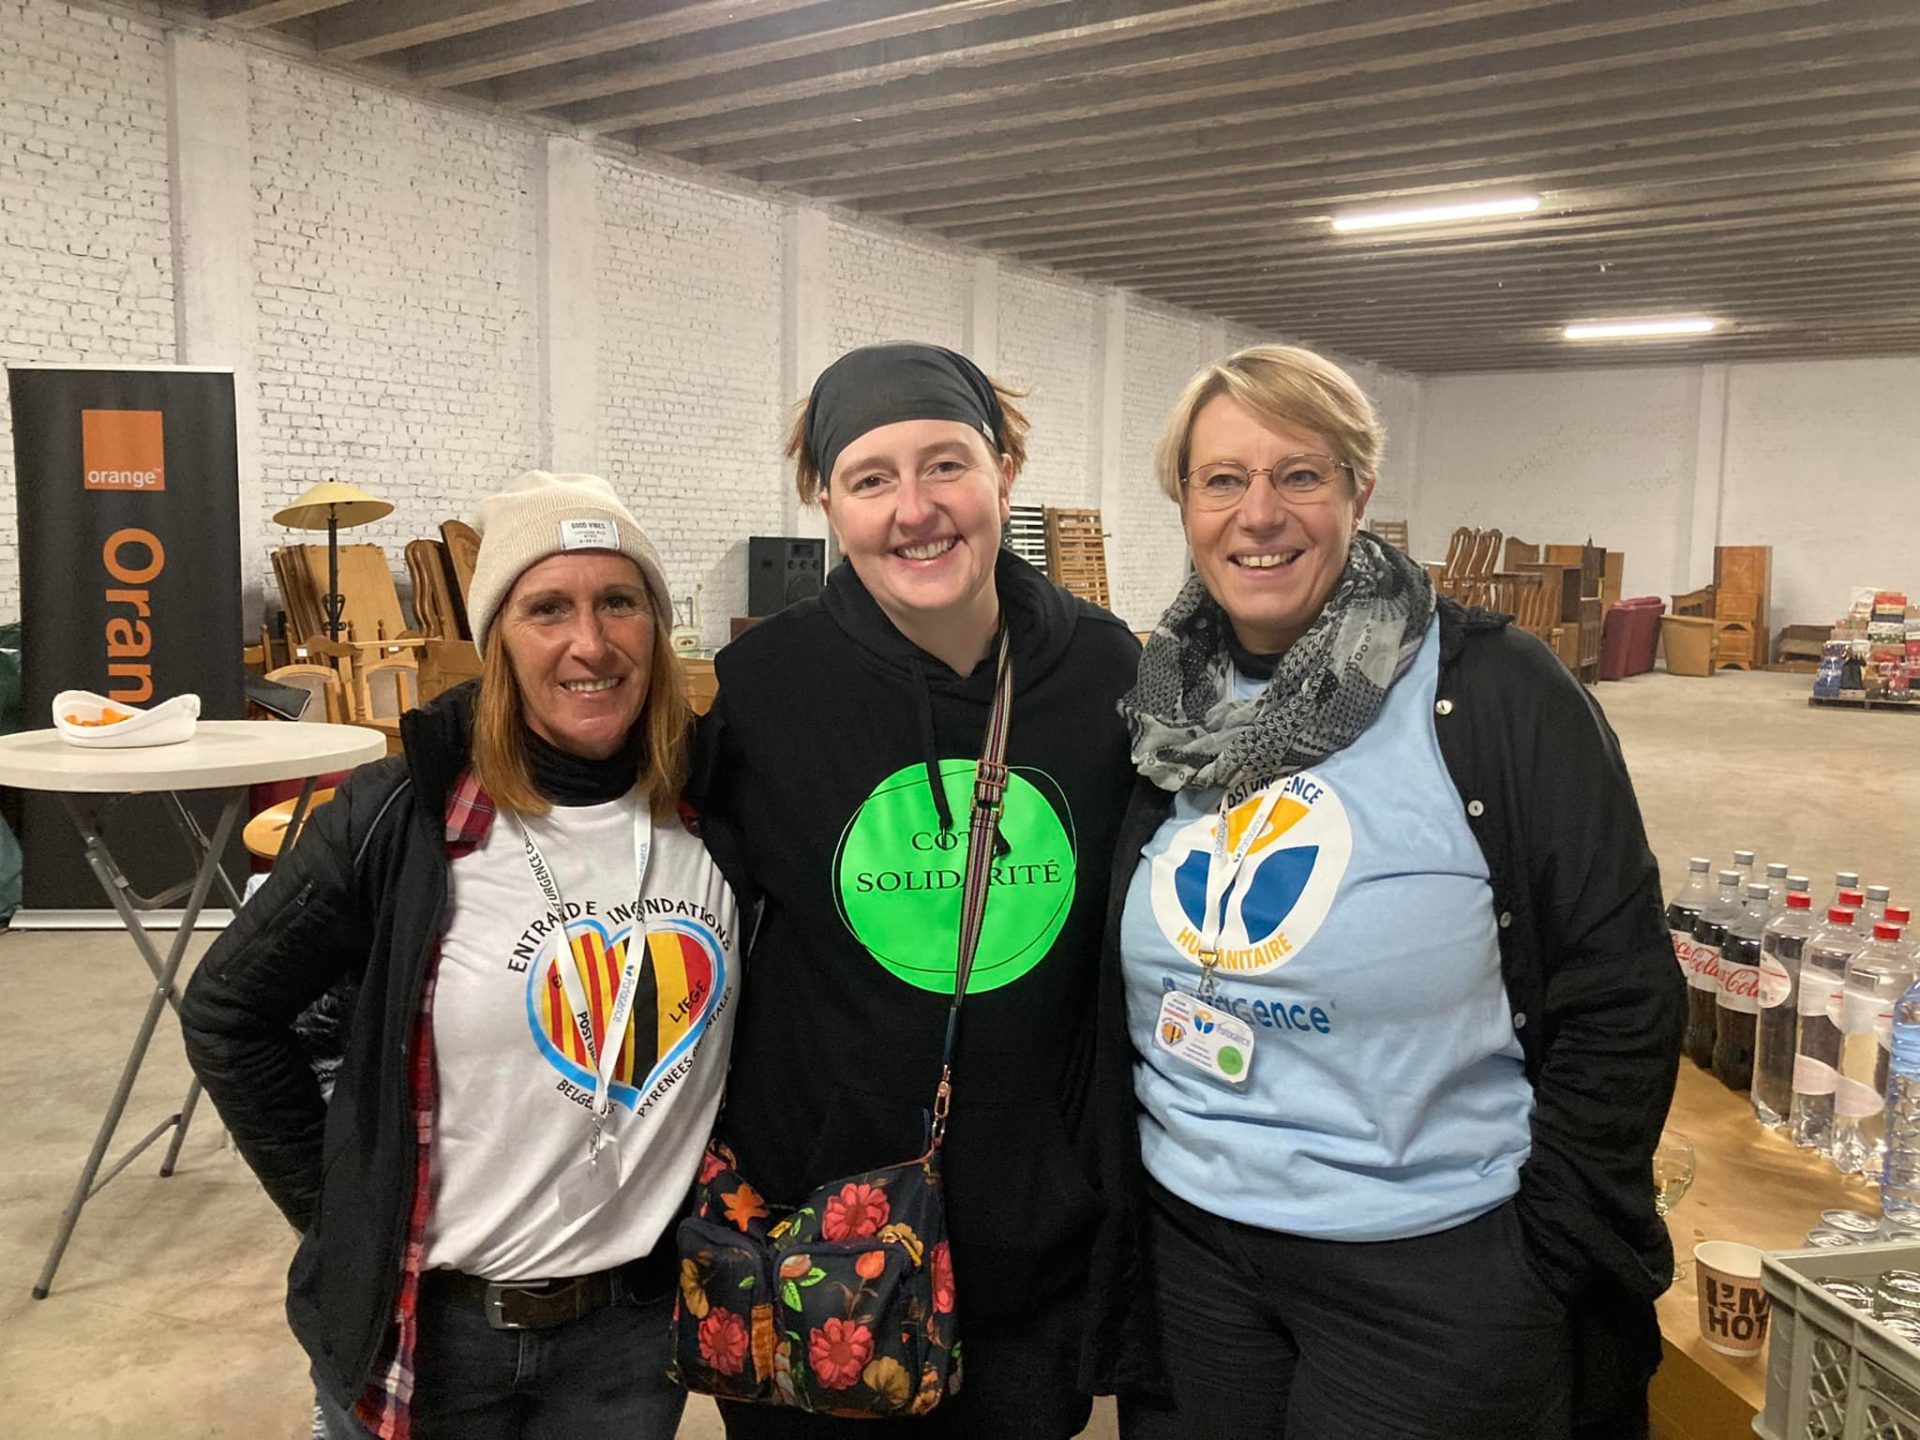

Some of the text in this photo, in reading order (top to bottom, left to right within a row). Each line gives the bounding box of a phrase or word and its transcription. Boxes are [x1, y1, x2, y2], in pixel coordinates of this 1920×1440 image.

[88, 471, 157, 487] orange
[103, 528, 165, 703] Oran
[856, 860, 1062, 892] SOLIDRITÉ
[1176, 926, 1292, 970] HUANITAIRE
[669, 980, 707, 1023] LIEGE
[577, 1011, 593, 1041] POST
[1708, 1305, 1769, 1340] HOT
